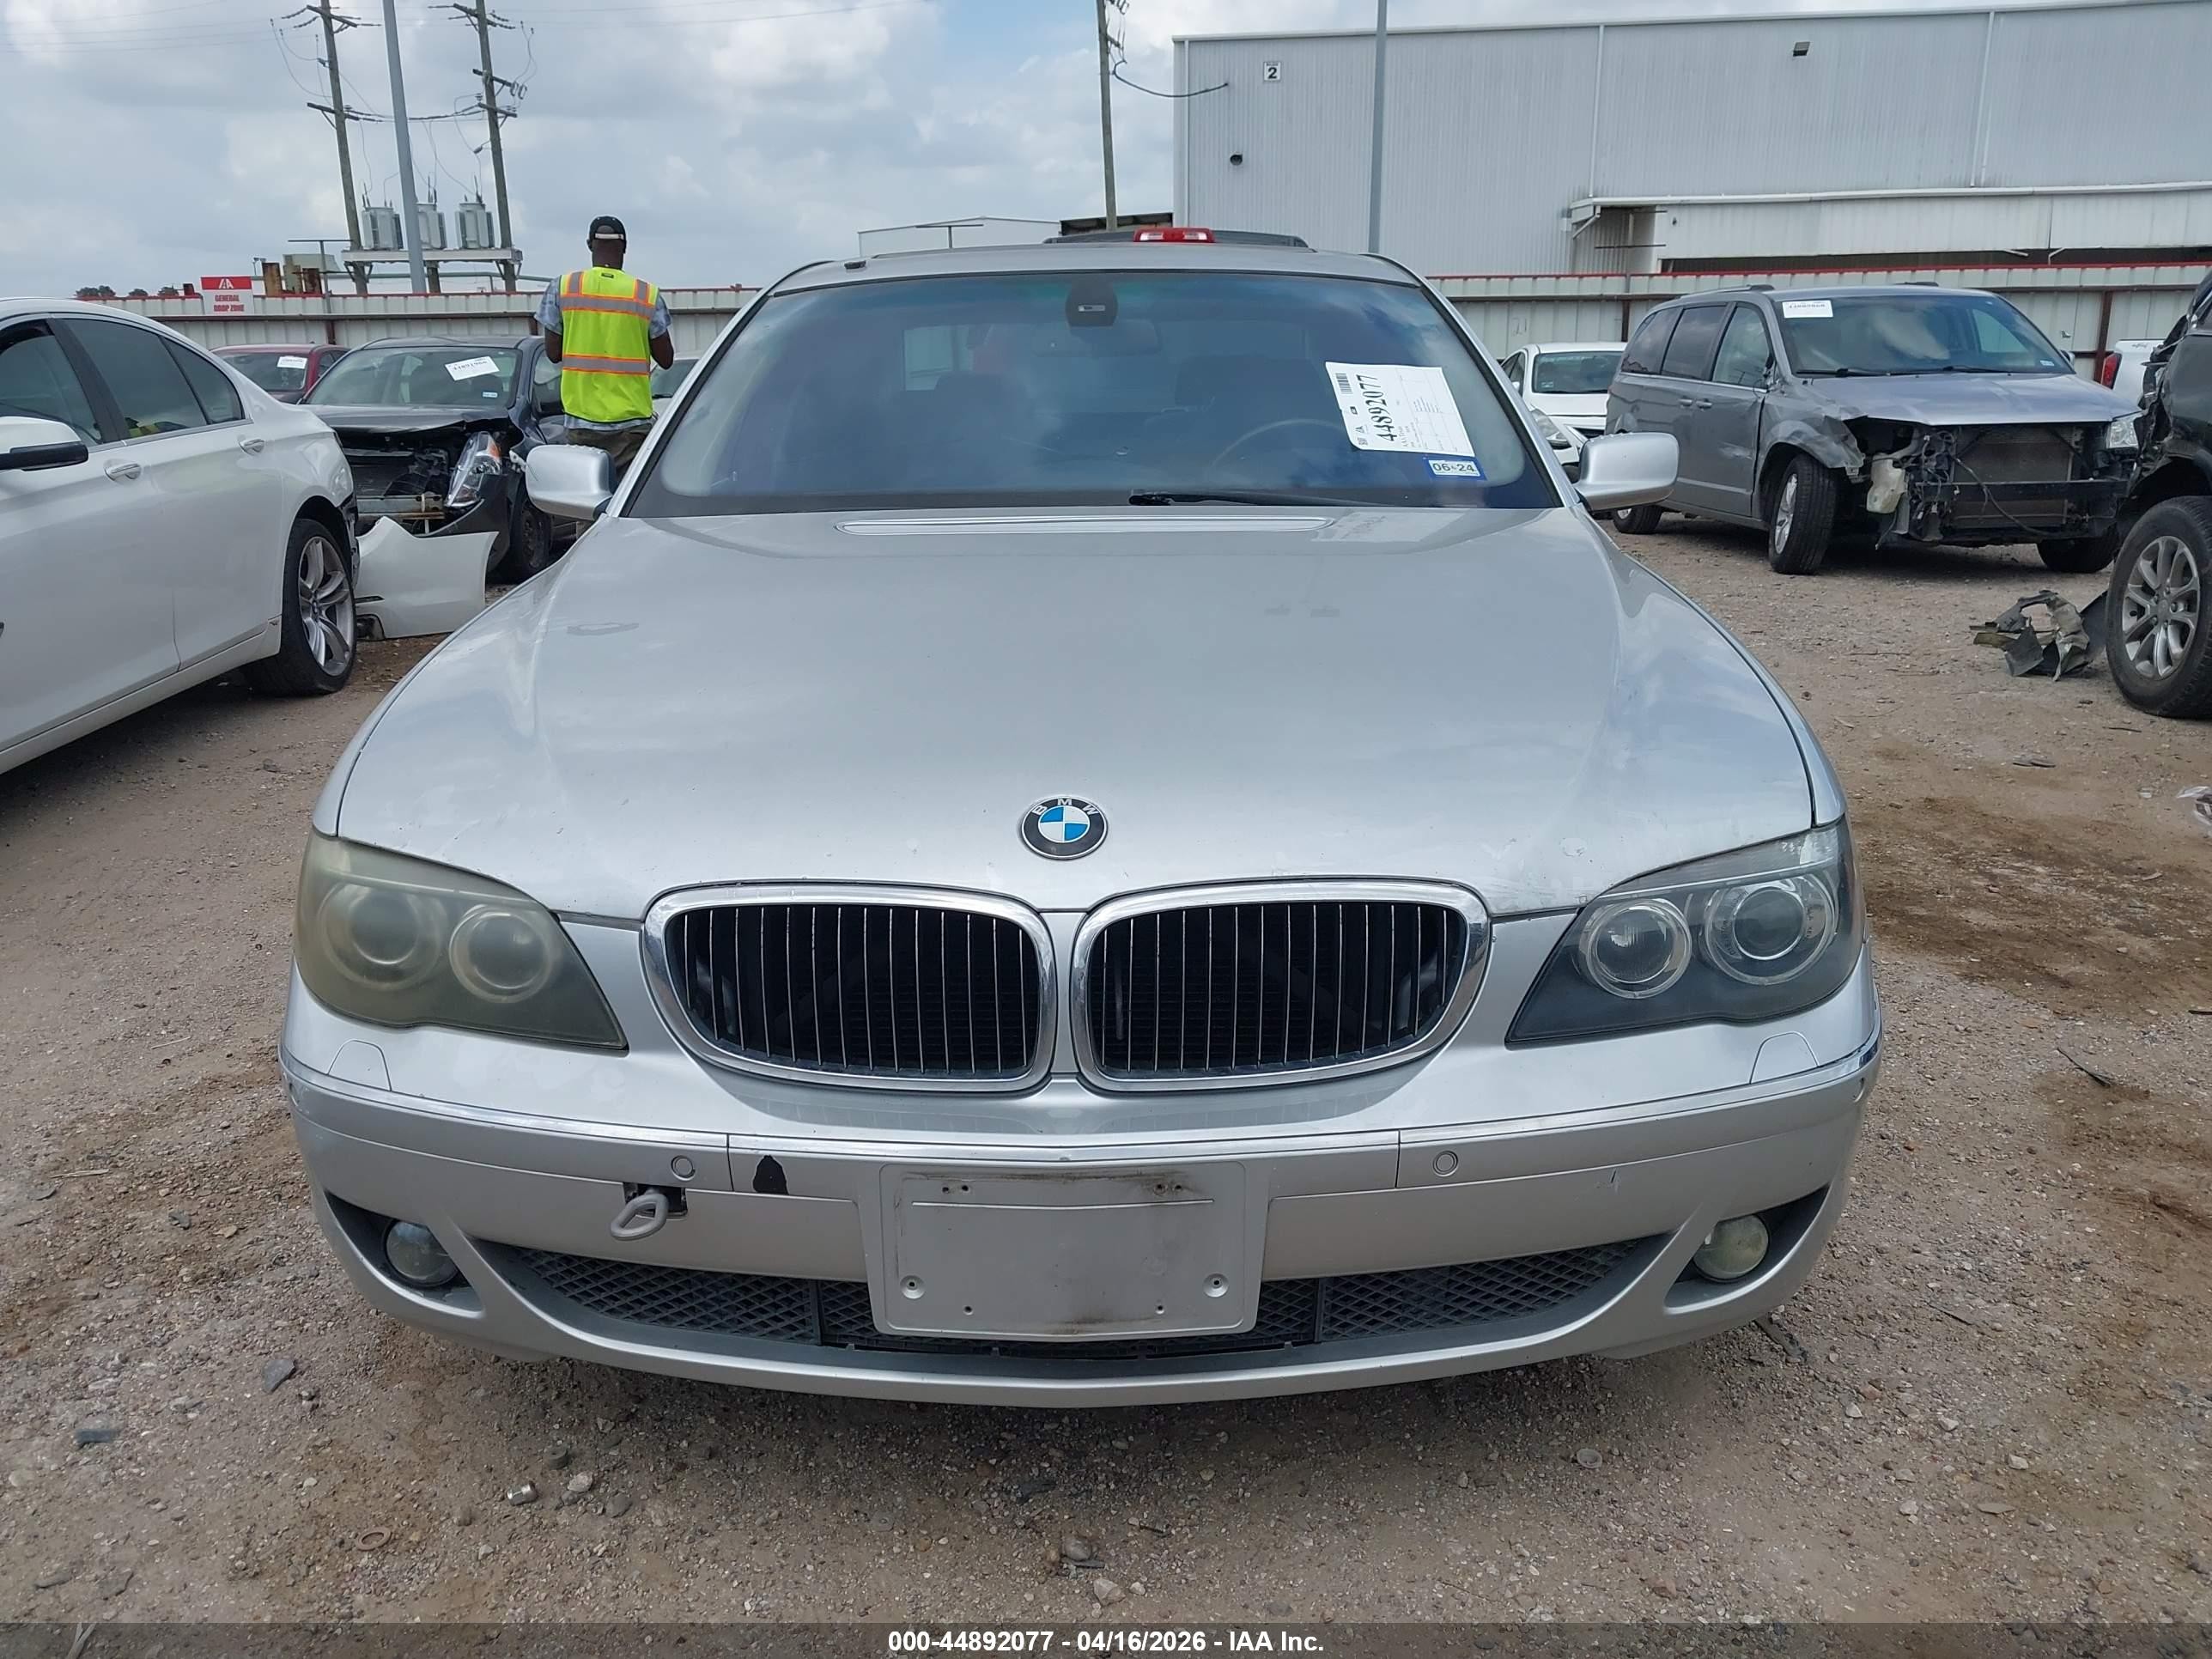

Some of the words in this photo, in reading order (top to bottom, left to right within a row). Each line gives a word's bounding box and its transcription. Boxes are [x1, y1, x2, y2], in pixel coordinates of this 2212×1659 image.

[1267, 67, 1278, 79] 2
[1355, 374, 1398, 441] 44892077
[1031, 797, 1099, 816] BMW
